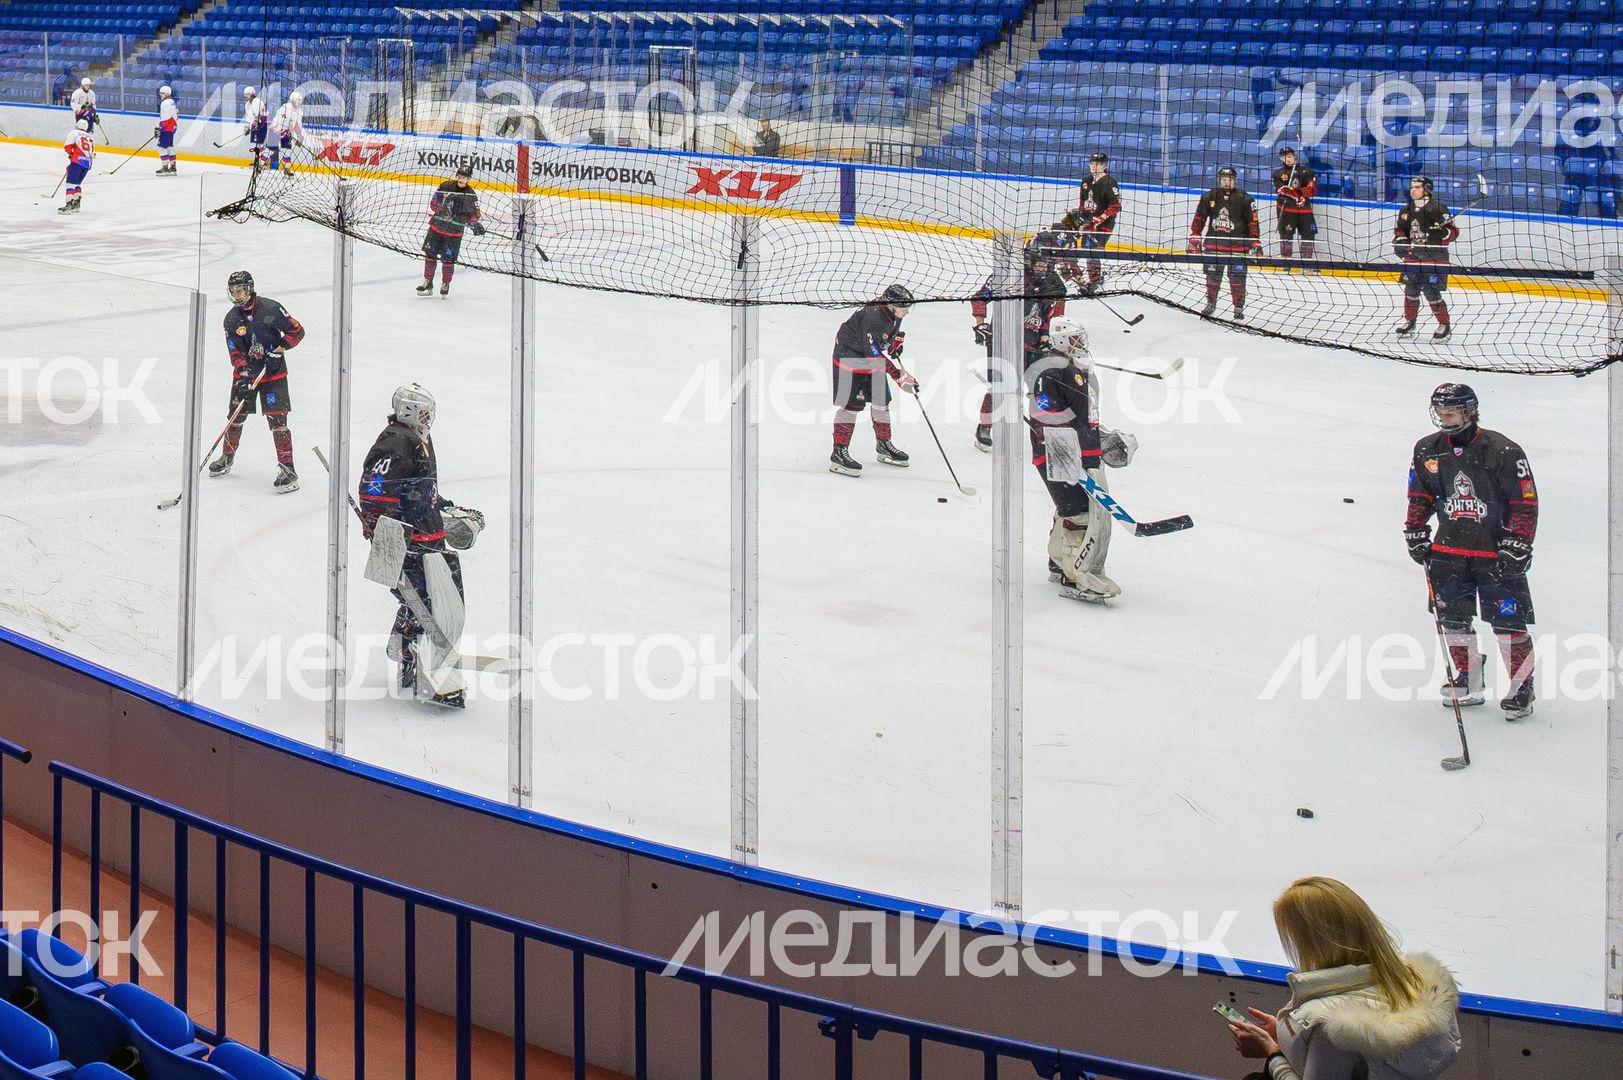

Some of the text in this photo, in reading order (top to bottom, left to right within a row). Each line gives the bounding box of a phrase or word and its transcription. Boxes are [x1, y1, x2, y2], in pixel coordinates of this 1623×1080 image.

[314, 138, 396, 166] X17
[417, 151, 516, 174] ХОККЕЙНАЯ
[531, 161, 657, 186] ЭКИПИРОВКА
[684, 166, 803, 201] X17
[374, 457, 392, 475] 40
[1079, 475, 1136, 524] X17
[1074, 536, 1096, 570] CCM
